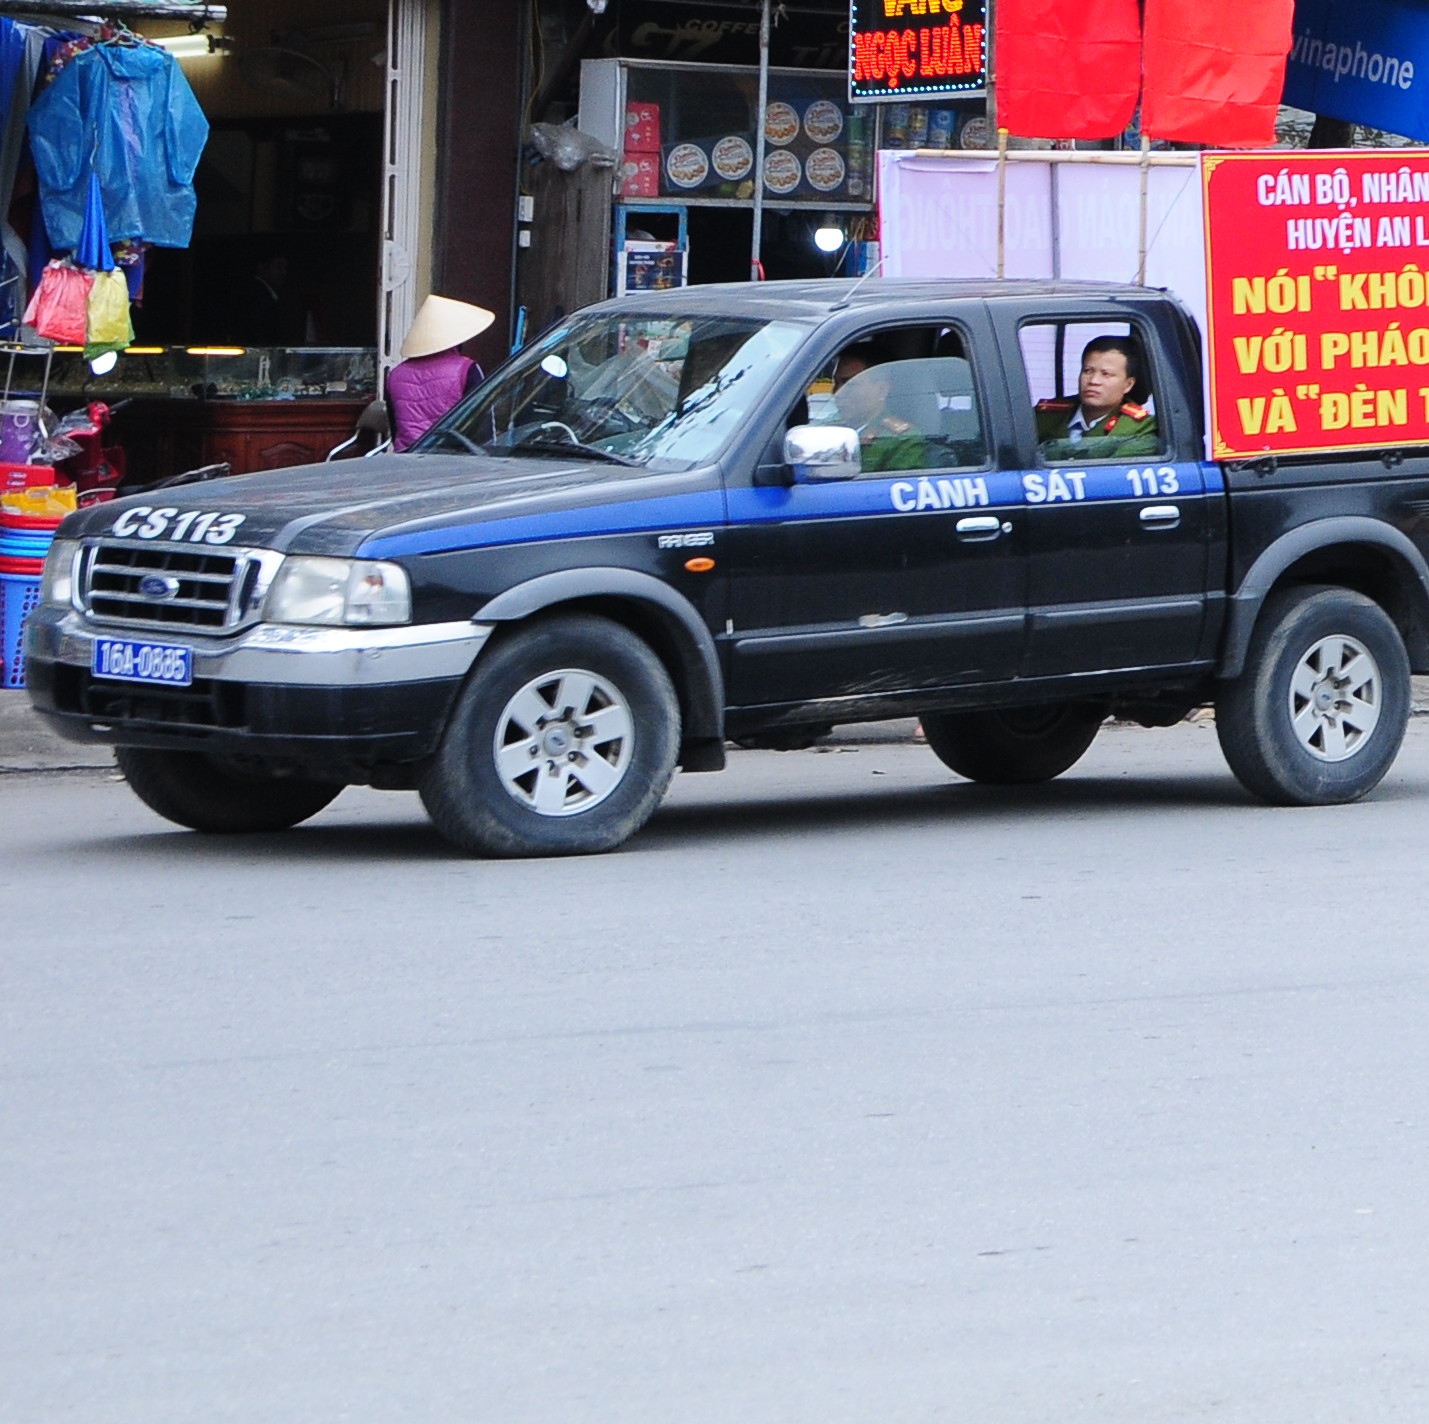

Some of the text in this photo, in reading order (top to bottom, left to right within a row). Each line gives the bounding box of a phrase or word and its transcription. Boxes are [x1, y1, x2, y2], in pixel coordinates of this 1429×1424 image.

[854, 13, 983, 88] NGỌC LUÂN
[1289, 29, 1414, 90] vinaphone
[1257, 168, 1311, 206] CÁN
[1315, 167, 1358, 210] BỘ,
[1286, 211, 1372, 255] HUYỆN
[1377, 215, 1411, 247] AN
[1232, 268, 1312, 315] NÓI
[1233, 327, 1308, 374] VỚI
[1236, 388, 1298, 436] VÀ
[889, 466, 1180, 514] CẢNH SÁT 113
[112, 506, 247, 544] CS113
